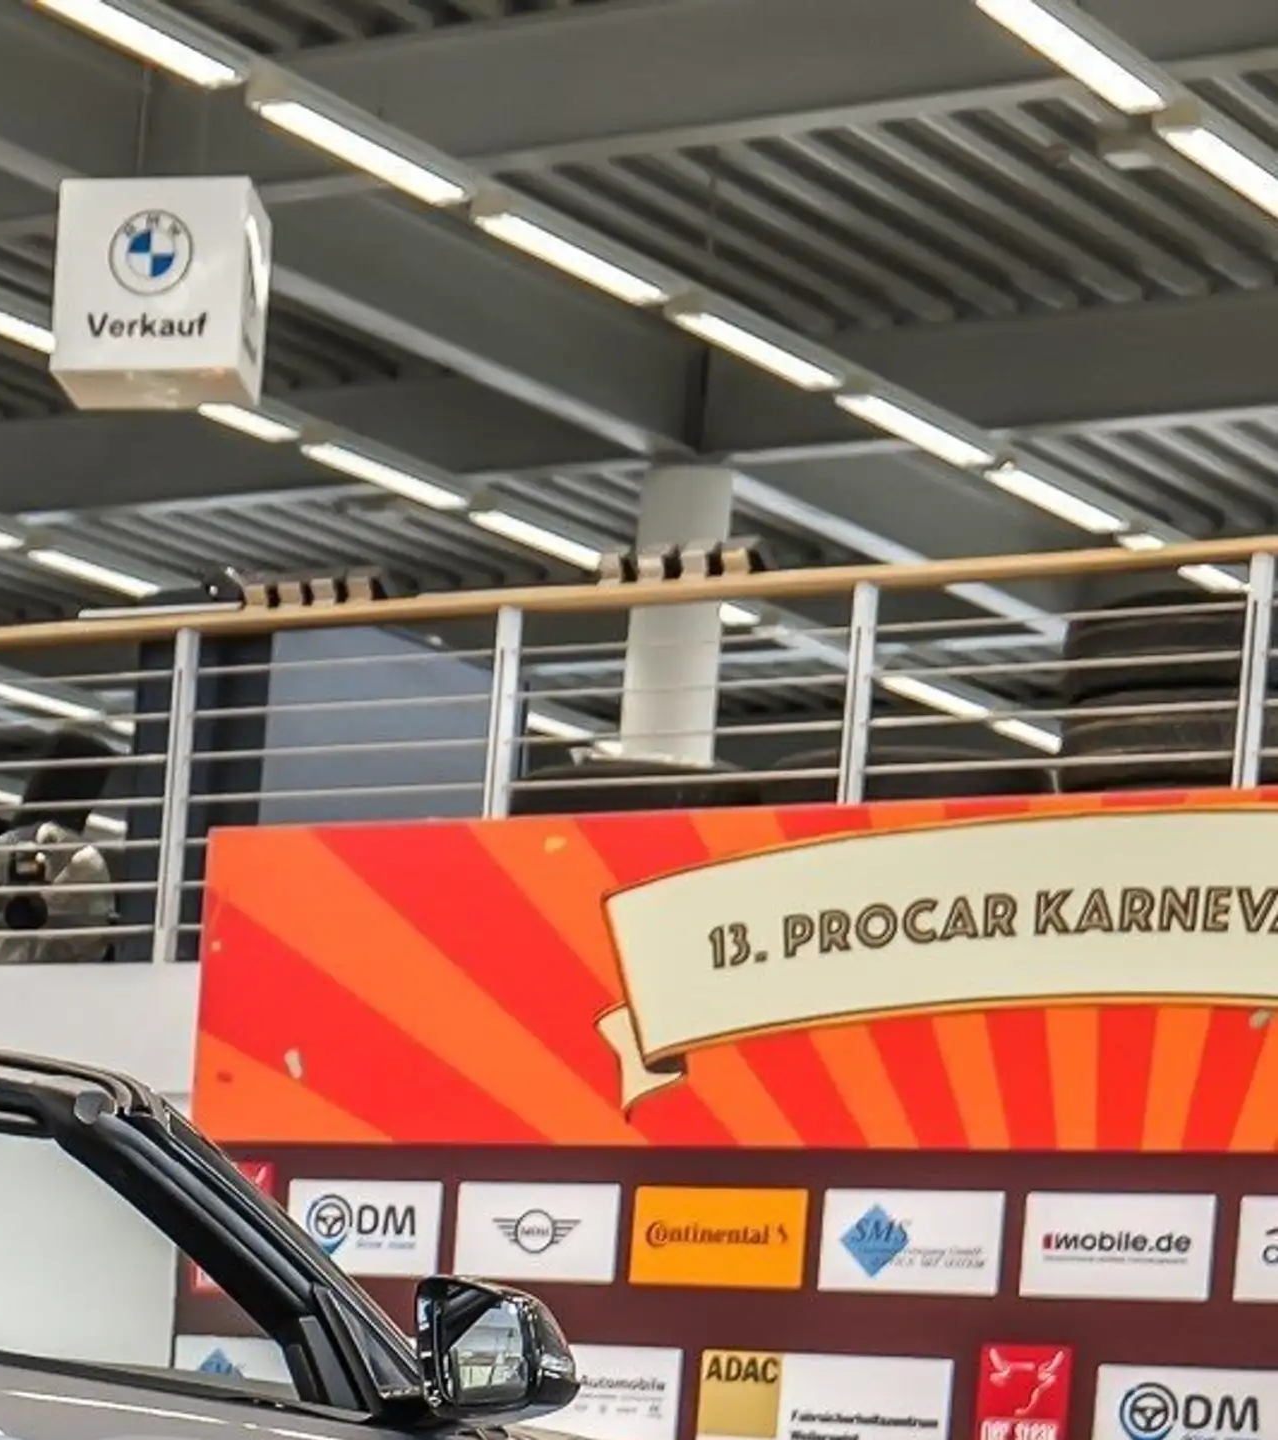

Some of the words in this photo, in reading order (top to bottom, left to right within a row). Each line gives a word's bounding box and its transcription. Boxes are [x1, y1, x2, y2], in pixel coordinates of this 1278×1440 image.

[87, 311, 207, 339] Verkauf
[709, 922, 767, 968] 13.
[783, 893, 1017, 958] PROCAR
[1034, 885, 1278, 935] KARNEV
[356, 1204, 416, 1236] DM
[852, 1218, 911, 1243] SMS
[646, 1221, 770, 1248] Continental
[1054, 1231, 1191, 1253] mobile.de
[705, 1357, 779, 1383] ADAC
[1183, 1394, 1259, 1432] DM
